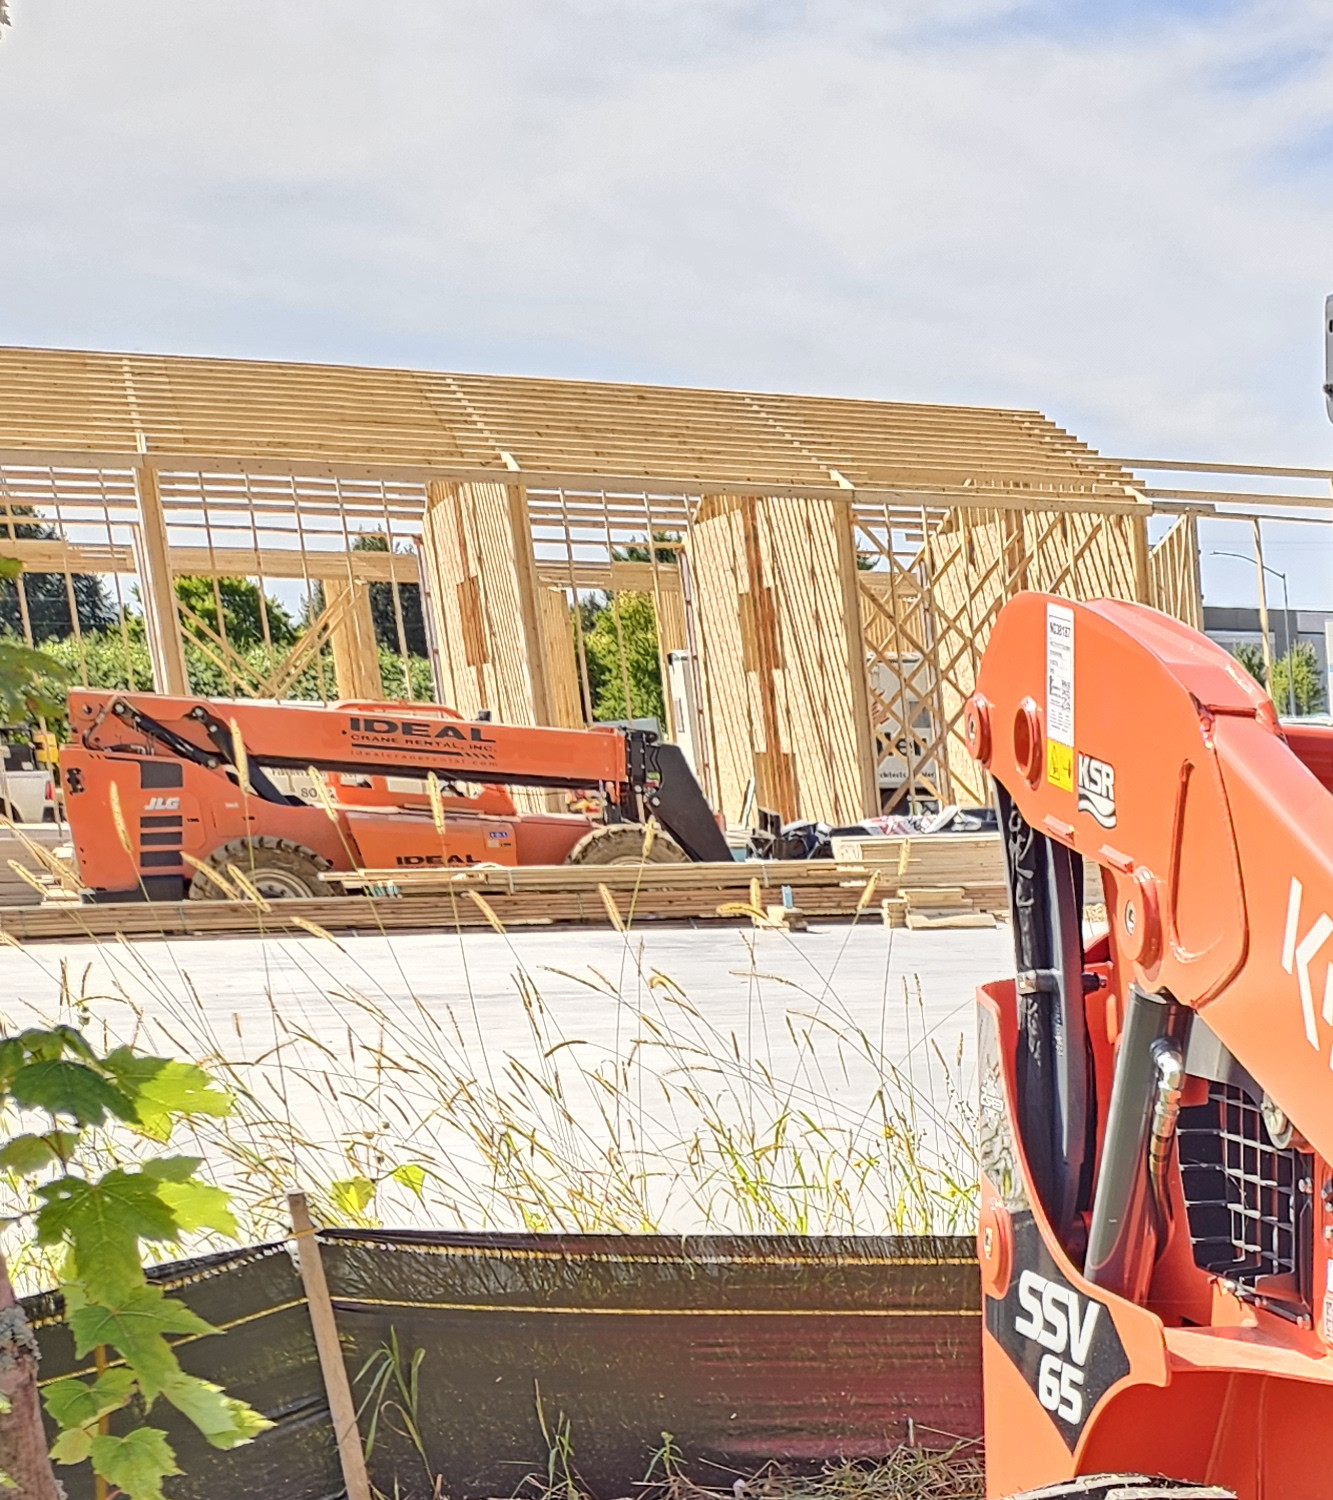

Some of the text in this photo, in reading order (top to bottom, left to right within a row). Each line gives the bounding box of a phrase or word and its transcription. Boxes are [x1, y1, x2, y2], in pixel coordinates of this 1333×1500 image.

[350, 717, 497, 744] IDEAL
[351, 734, 498, 753] CRANE RENTAL, INC.
[1078, 752, 1115, 801] KSR
[144, 796, 181, 811] JLG
[395, 854, 482, 866] IDEAL
[1015, 1269, 1101, 1367] SSV
[1038, 1353, 1085, 1425] 65
